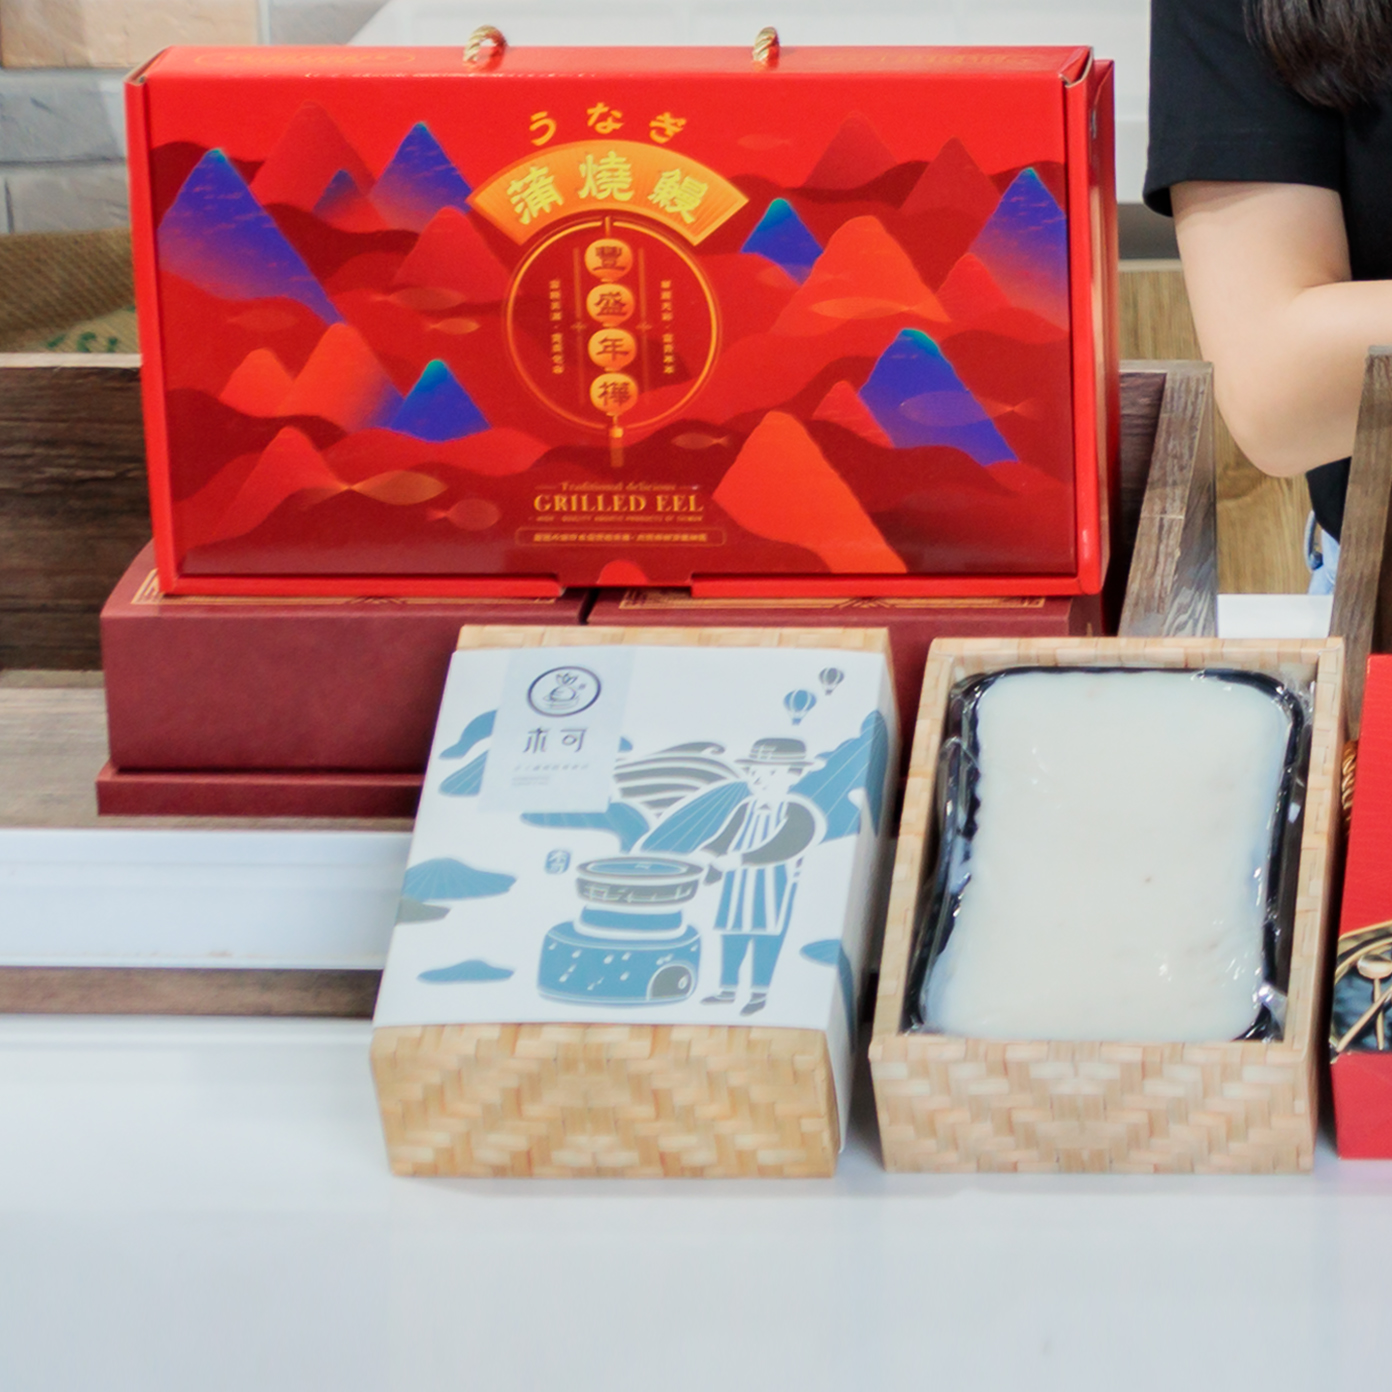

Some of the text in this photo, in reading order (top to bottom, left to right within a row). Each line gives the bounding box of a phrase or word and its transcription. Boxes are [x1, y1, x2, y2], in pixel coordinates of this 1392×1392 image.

[529, 102, 687, 146] うなぎ
[506, 150, 708, 225] 蒲燒鰻
[533, 494, 704, 512] GRILLED EEL
